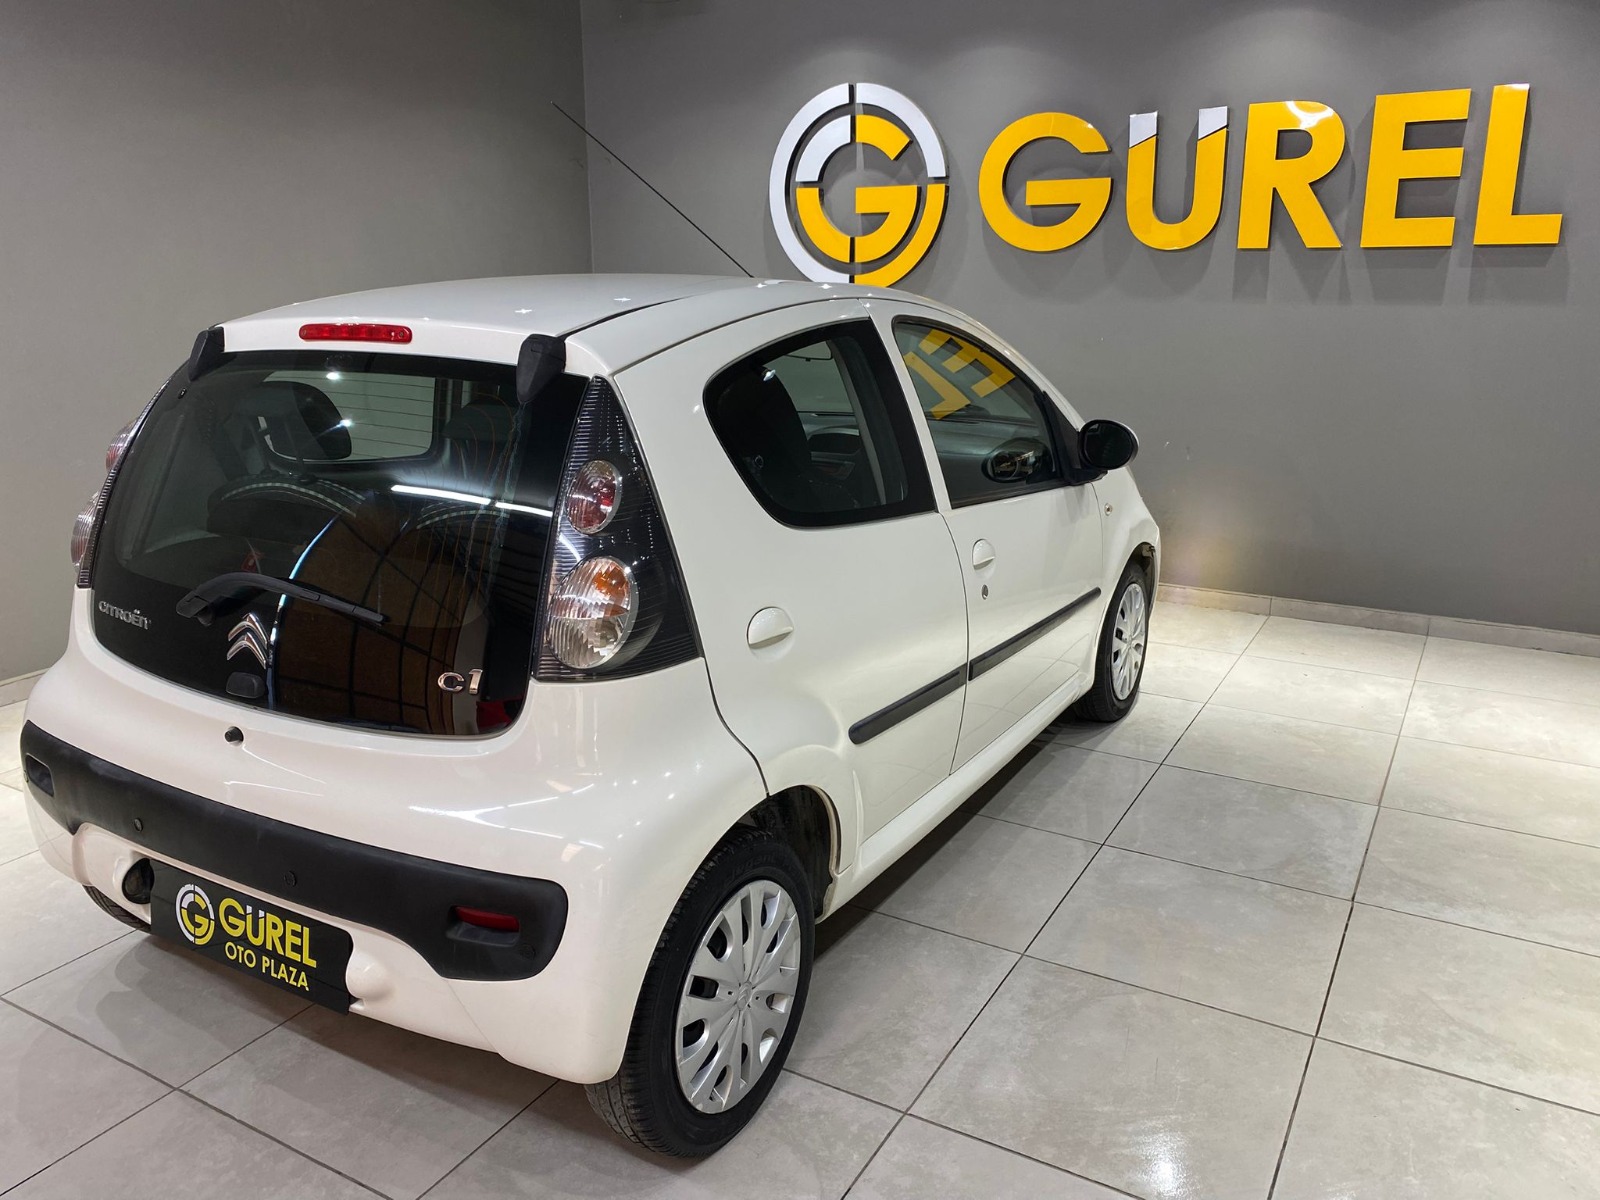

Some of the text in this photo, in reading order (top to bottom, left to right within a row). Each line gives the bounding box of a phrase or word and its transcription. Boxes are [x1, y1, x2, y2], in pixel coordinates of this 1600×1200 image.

[437, 668, 483, 695] C1
[224, 941, 310, 991] OTO PLAZA
